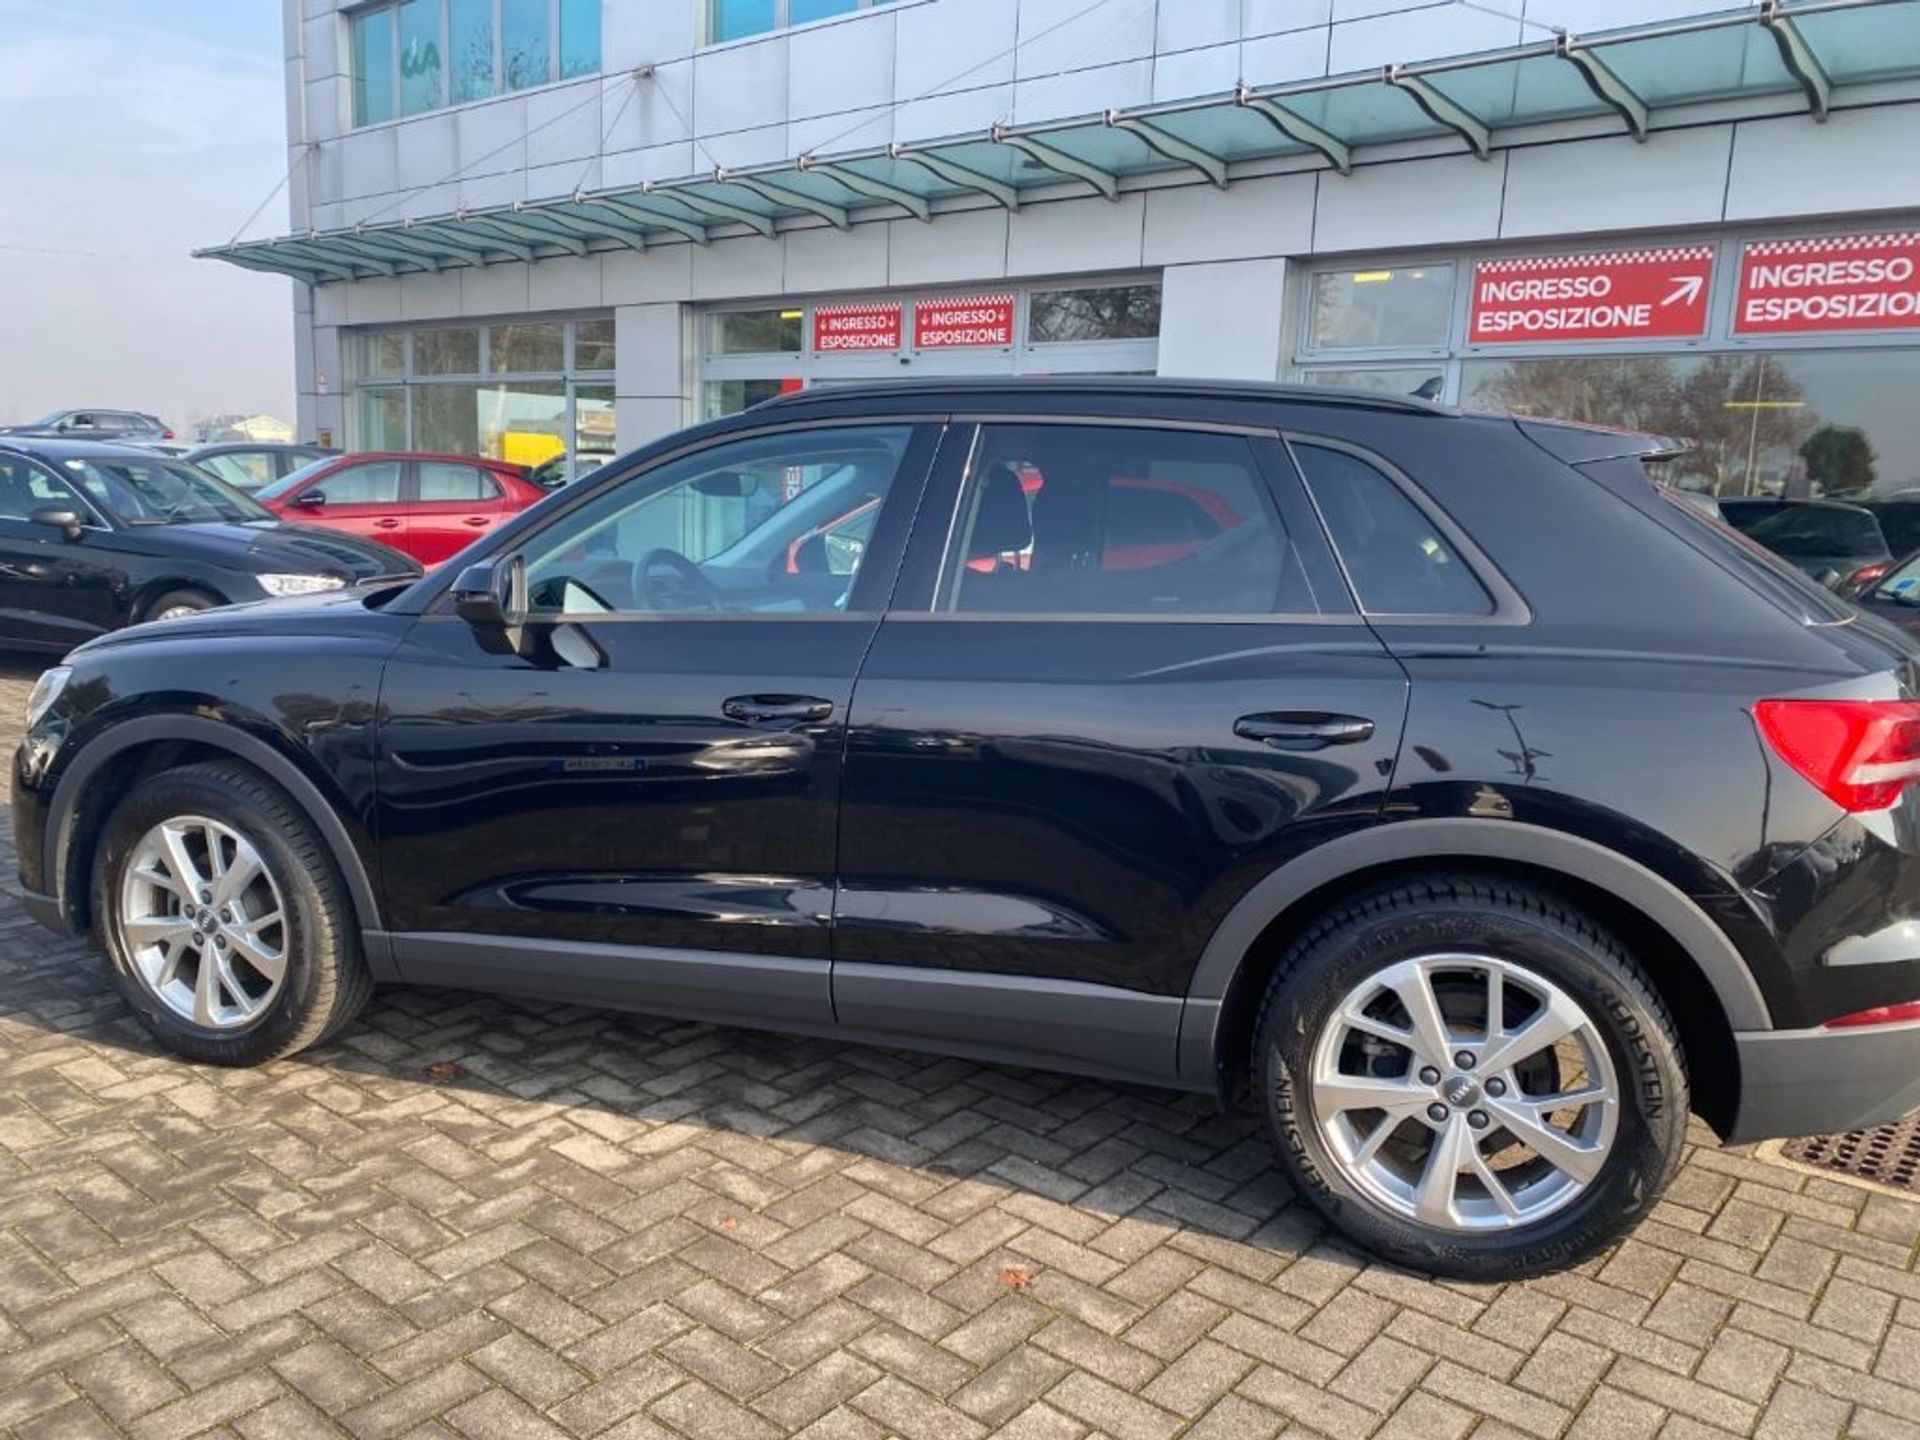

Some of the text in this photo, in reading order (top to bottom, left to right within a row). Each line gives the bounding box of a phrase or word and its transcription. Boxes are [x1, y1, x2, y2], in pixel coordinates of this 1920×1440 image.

[1751, 257, 1914, 289] INGRESSO
[1480, 276, 1611, 302] INGRESSO
[1745, 291, 1920, 322] ESPOSIZIO
[829, 316, 887, 330] INGRESSO
[931, 310, 997, 325] INGRESSO
[1478, 304, 1652, 333] ESPOSIZIONE
[821, 334, 896, 349] ESPOSIZIONE
[921, 328, 1006, 345] ESPOSIZIONE
